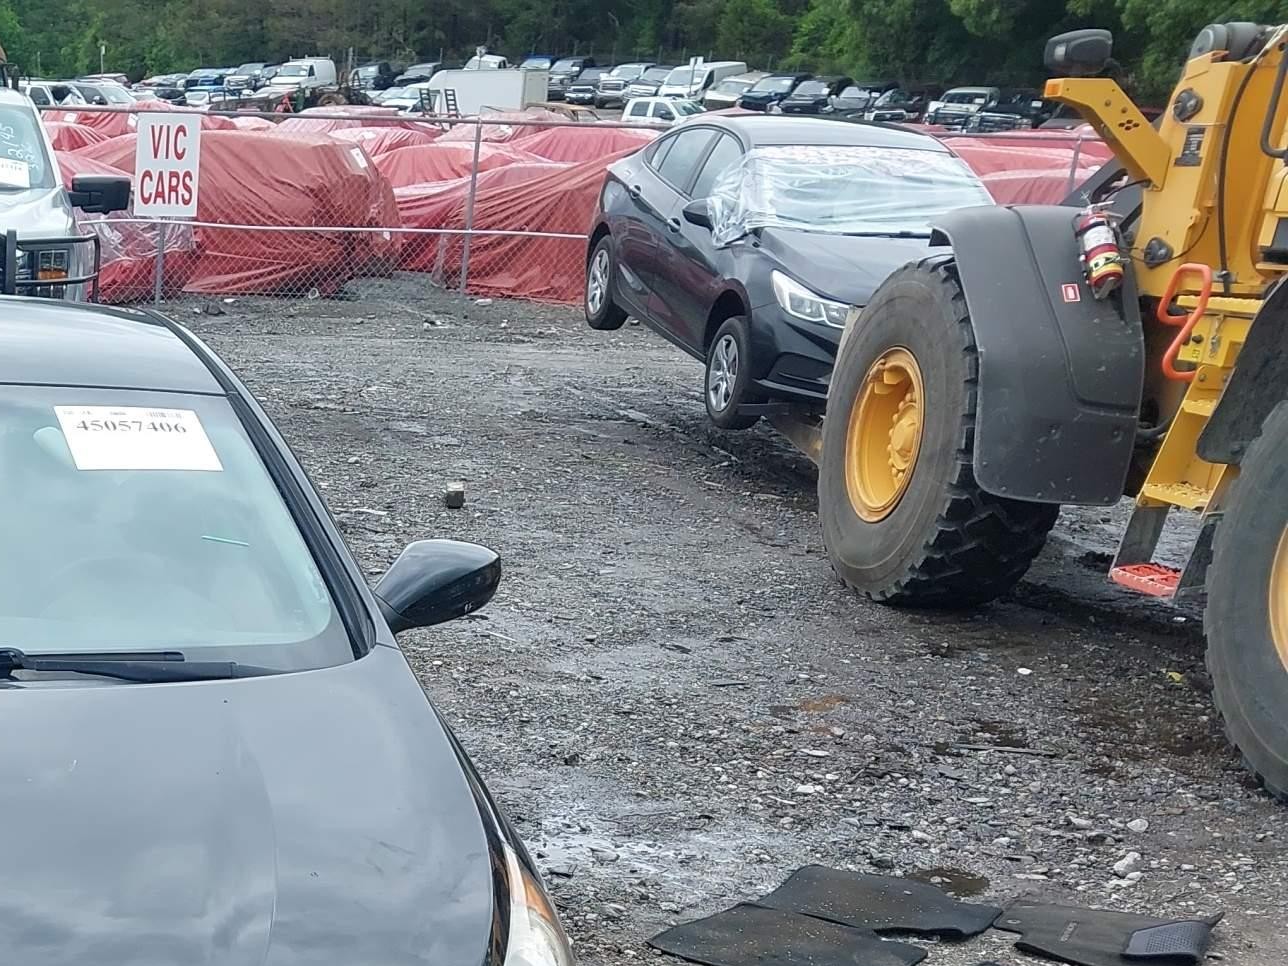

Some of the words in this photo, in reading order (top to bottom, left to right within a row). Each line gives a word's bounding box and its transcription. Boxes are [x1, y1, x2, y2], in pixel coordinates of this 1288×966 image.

[150, 124, 187, 160] VIC
[140, 169, 193, 206] CARS
[76, 420, 187, 433] 45057406
